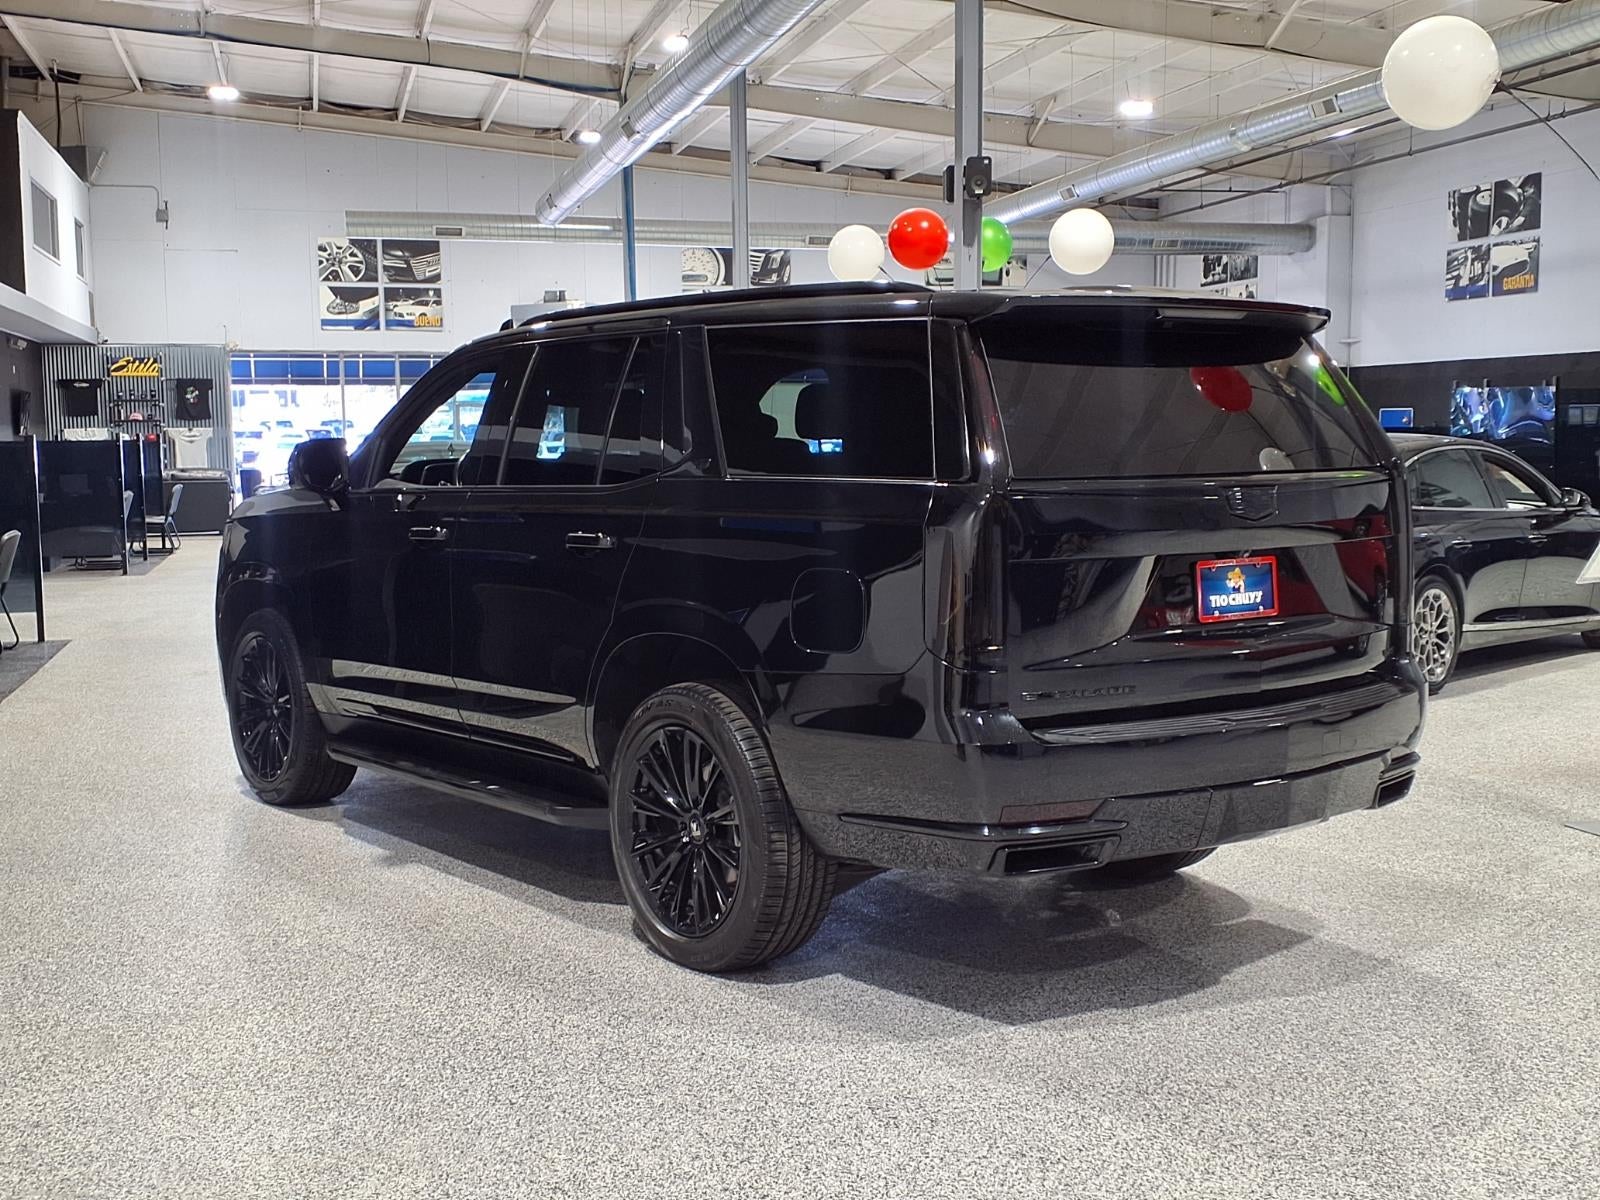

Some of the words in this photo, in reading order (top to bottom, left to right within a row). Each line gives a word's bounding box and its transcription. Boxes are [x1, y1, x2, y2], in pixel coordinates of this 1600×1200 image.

[414, 314, 441, 327] BUENO
[110, 356, 159, 377] Estilo
[1209, 594, 1229, 607] TIO
[1021, 684, 1137, 701] ECALADE
